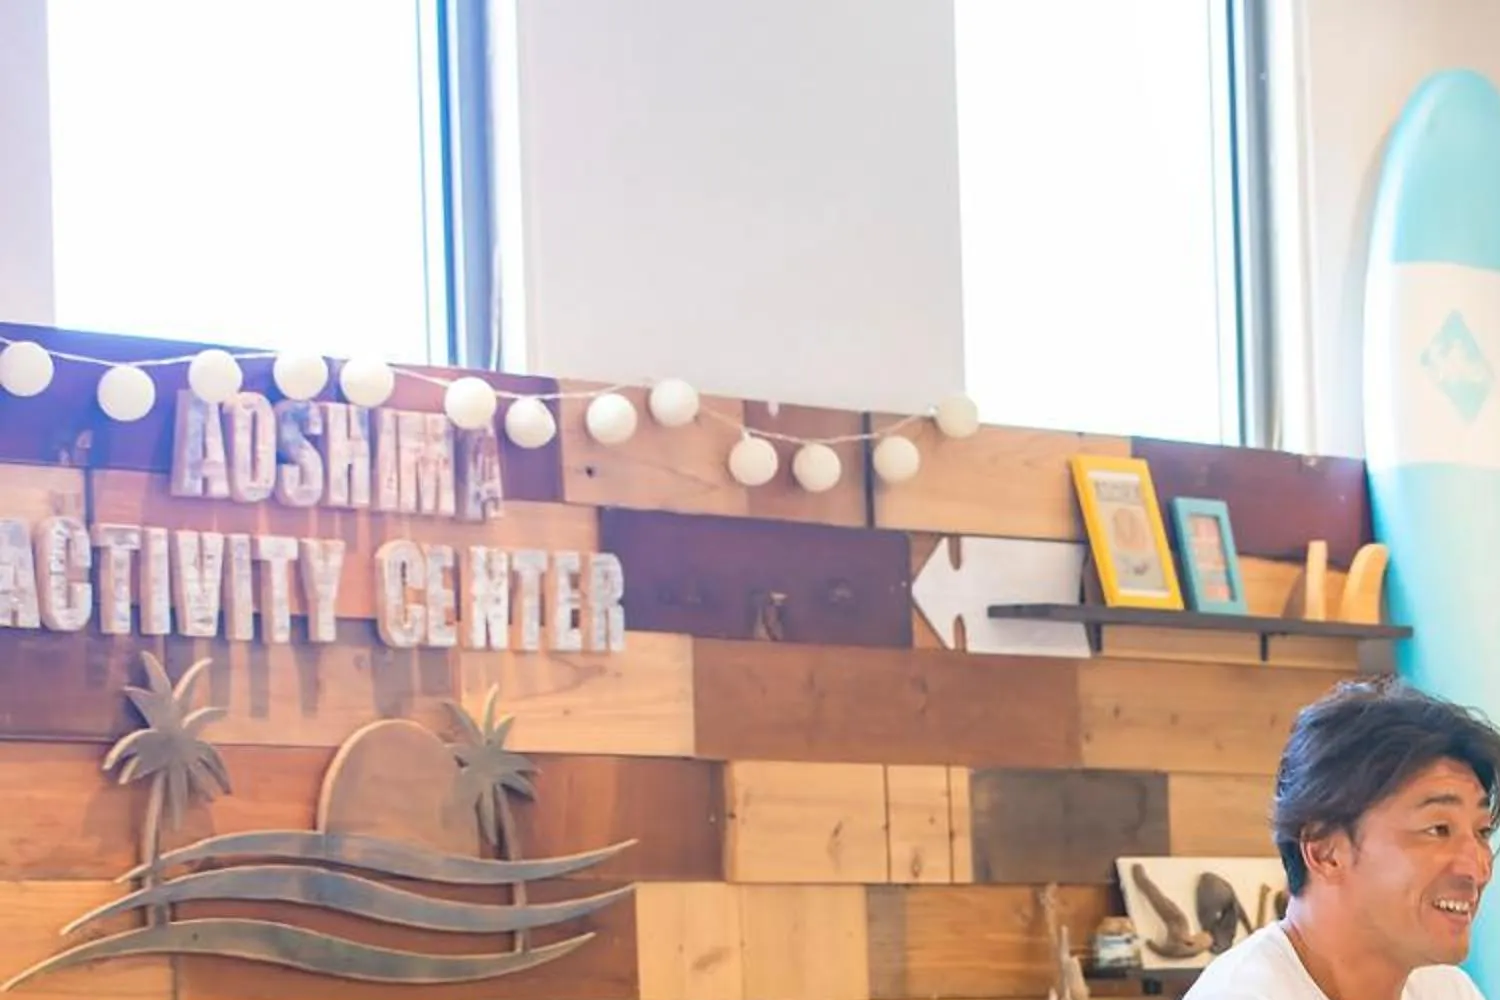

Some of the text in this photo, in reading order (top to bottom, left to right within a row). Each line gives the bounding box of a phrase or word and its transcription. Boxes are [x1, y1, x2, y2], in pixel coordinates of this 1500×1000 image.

[171, 388, 503, 522] AOSHIMA
[0, 516, 626, 653] ACTIVITY CENTER
